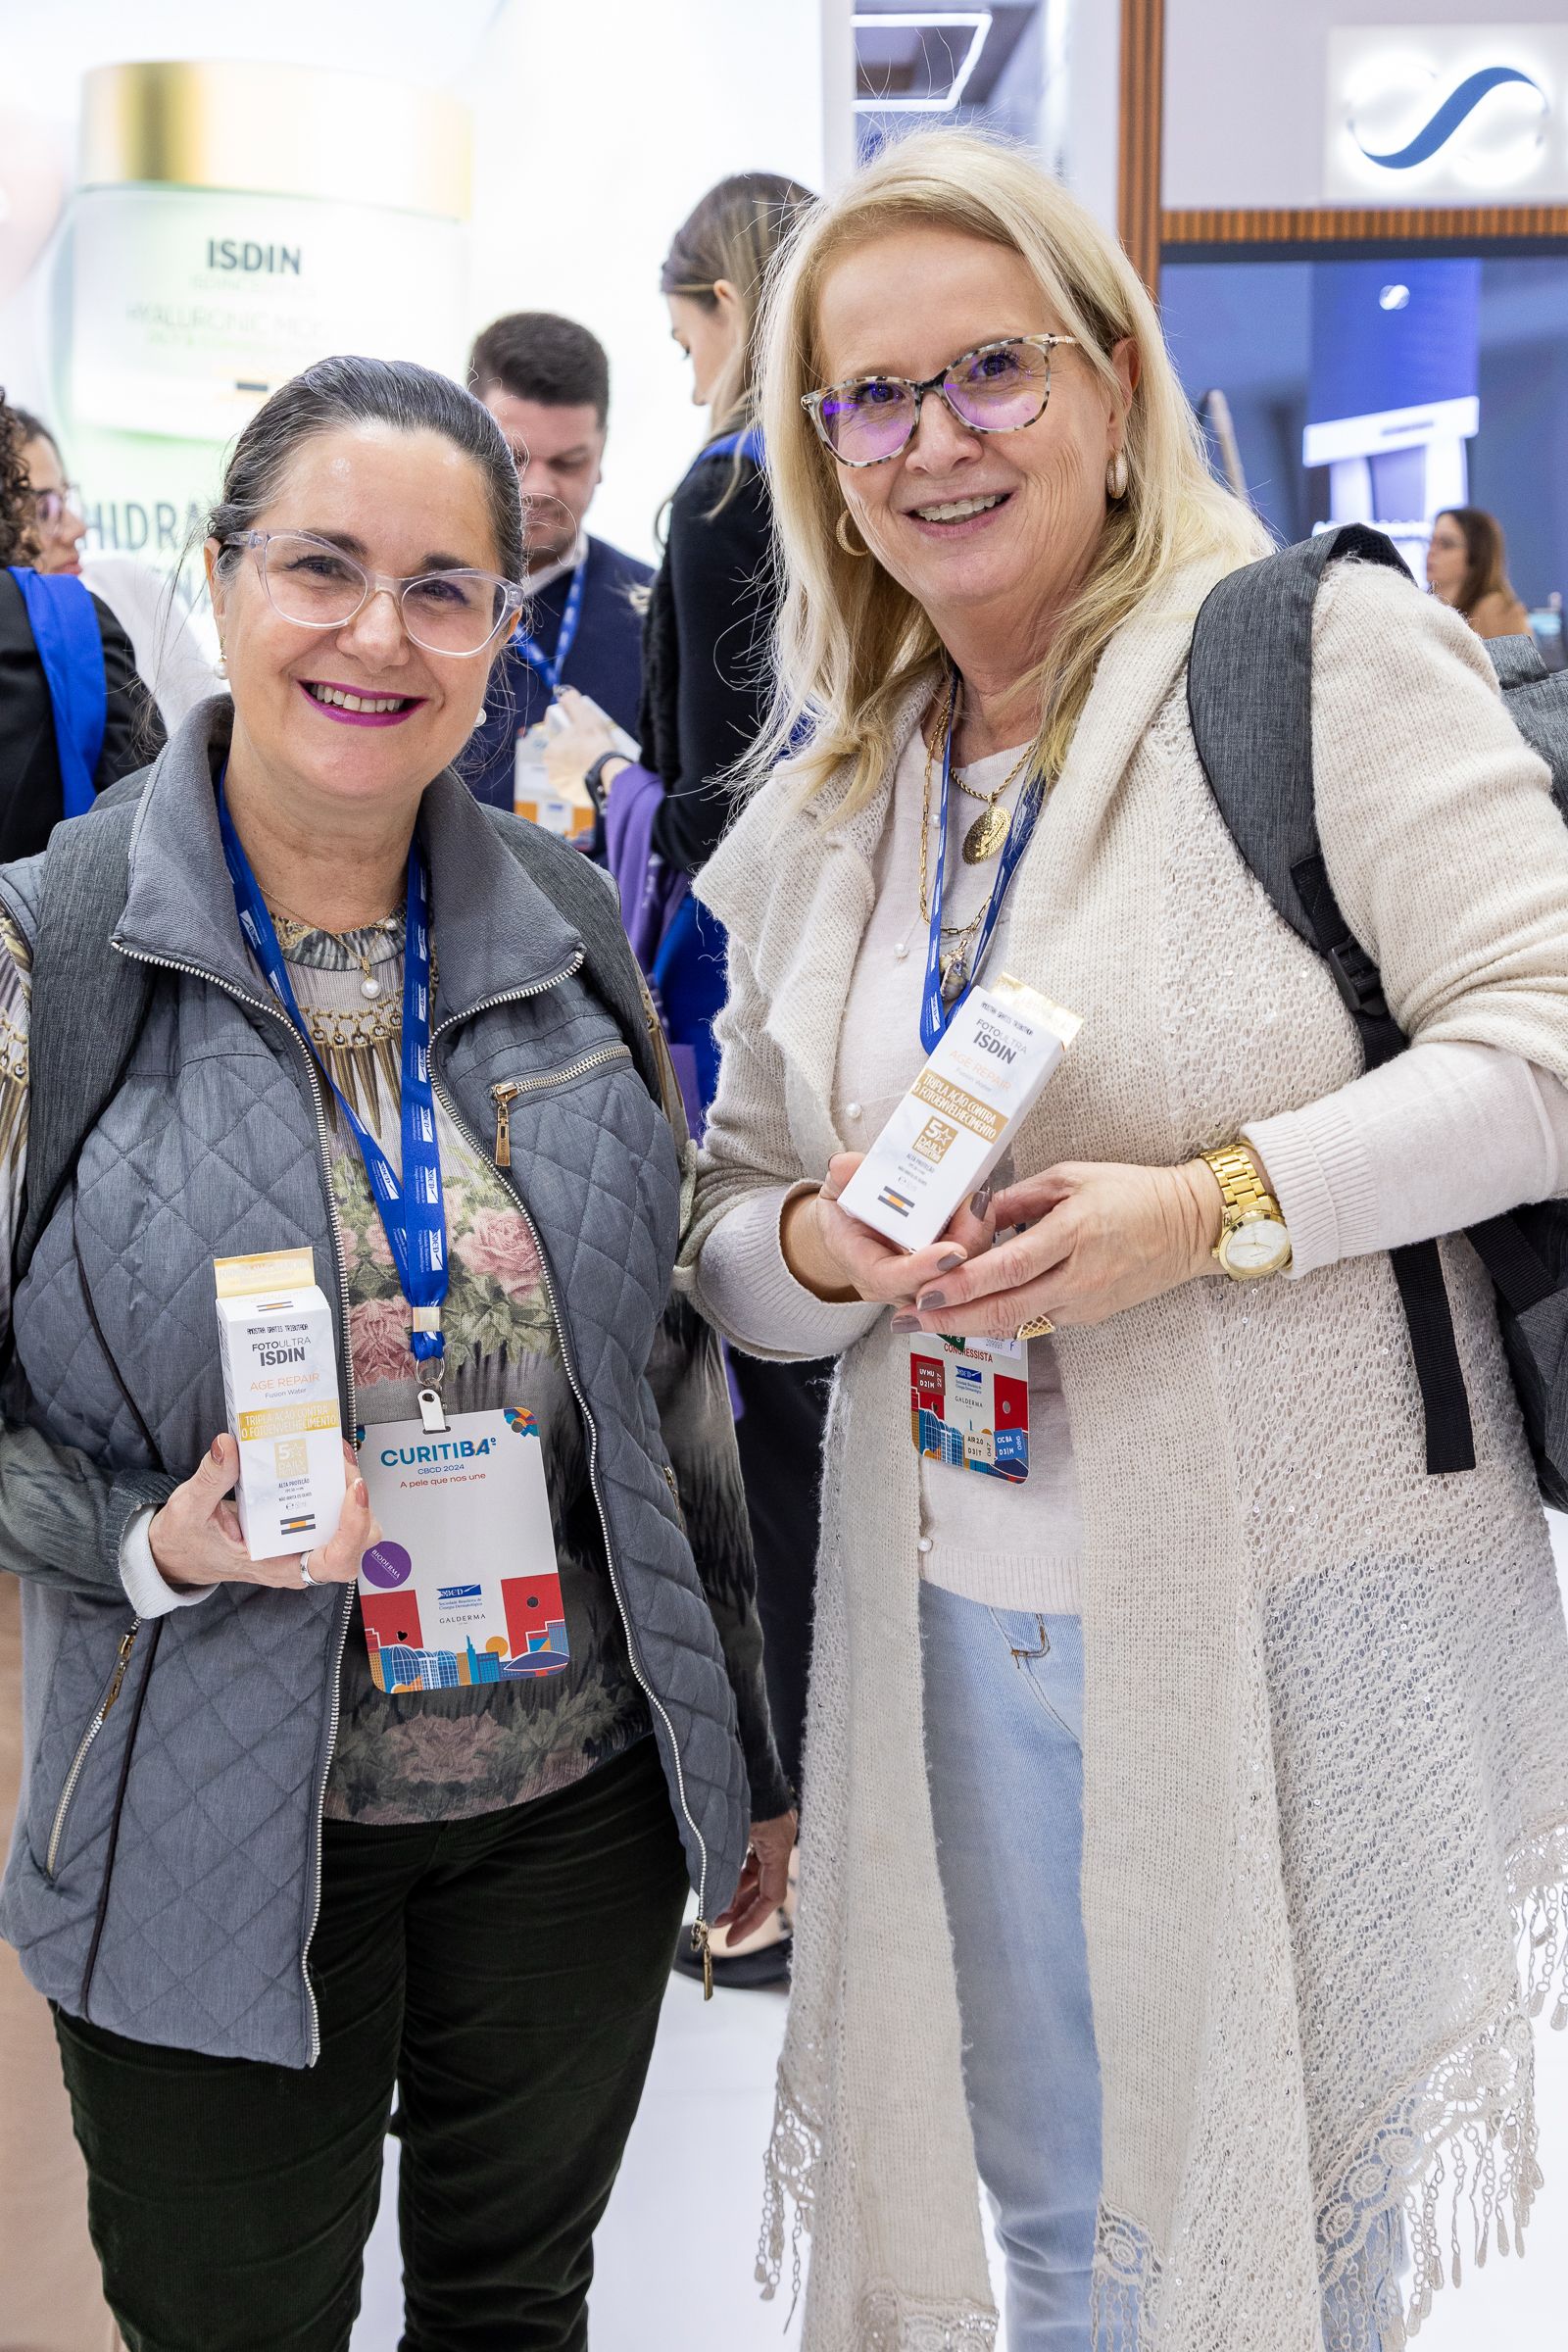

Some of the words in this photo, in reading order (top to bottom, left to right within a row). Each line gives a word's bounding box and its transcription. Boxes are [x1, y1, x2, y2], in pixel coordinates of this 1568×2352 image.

[208, 239, 302, 274] ISDIN
[976, 1019, 1026, 1054] FOTOULTRA
[973, 1031, 1016, 1064] ISDIN
[950, 1051, 972, 1067] AGE
[973, 1063, 1011, 1091] REPAIR
[923, 1074, 949, 1097] TRIPLA
[948, 1090, 969, 1107] AÇÃO
[968, 1102, 996, 1125] CONTRA
[919, 1087, 997, 1140] FOTOENVELHECIMENTO
[925, 1119, 942, 1138] 5
[920, 1136, 946, 1155] DAILY
[252, 1337, 312, 1351] FOTOULTRA
[260, 1347, 305, 1366] ISDIN
[251, 1380, 274, 1391] AGE
[278, 1373, 320, 1387] REPAIR
[956, 1396, 983, 1407] GALDERMA
[246, 1412, 276, 1426] TRIPLA
[298, 1405, 328, 1418] CONTRA
[242, 1428, 247, 1438] O
[279, 1443, 291, 1460] 5
[410, 1479, 428, 1488] pele
[372, 1549, 400, 1579] BIODERMA
[439, 1614, 486, 1624] GALDERMA
